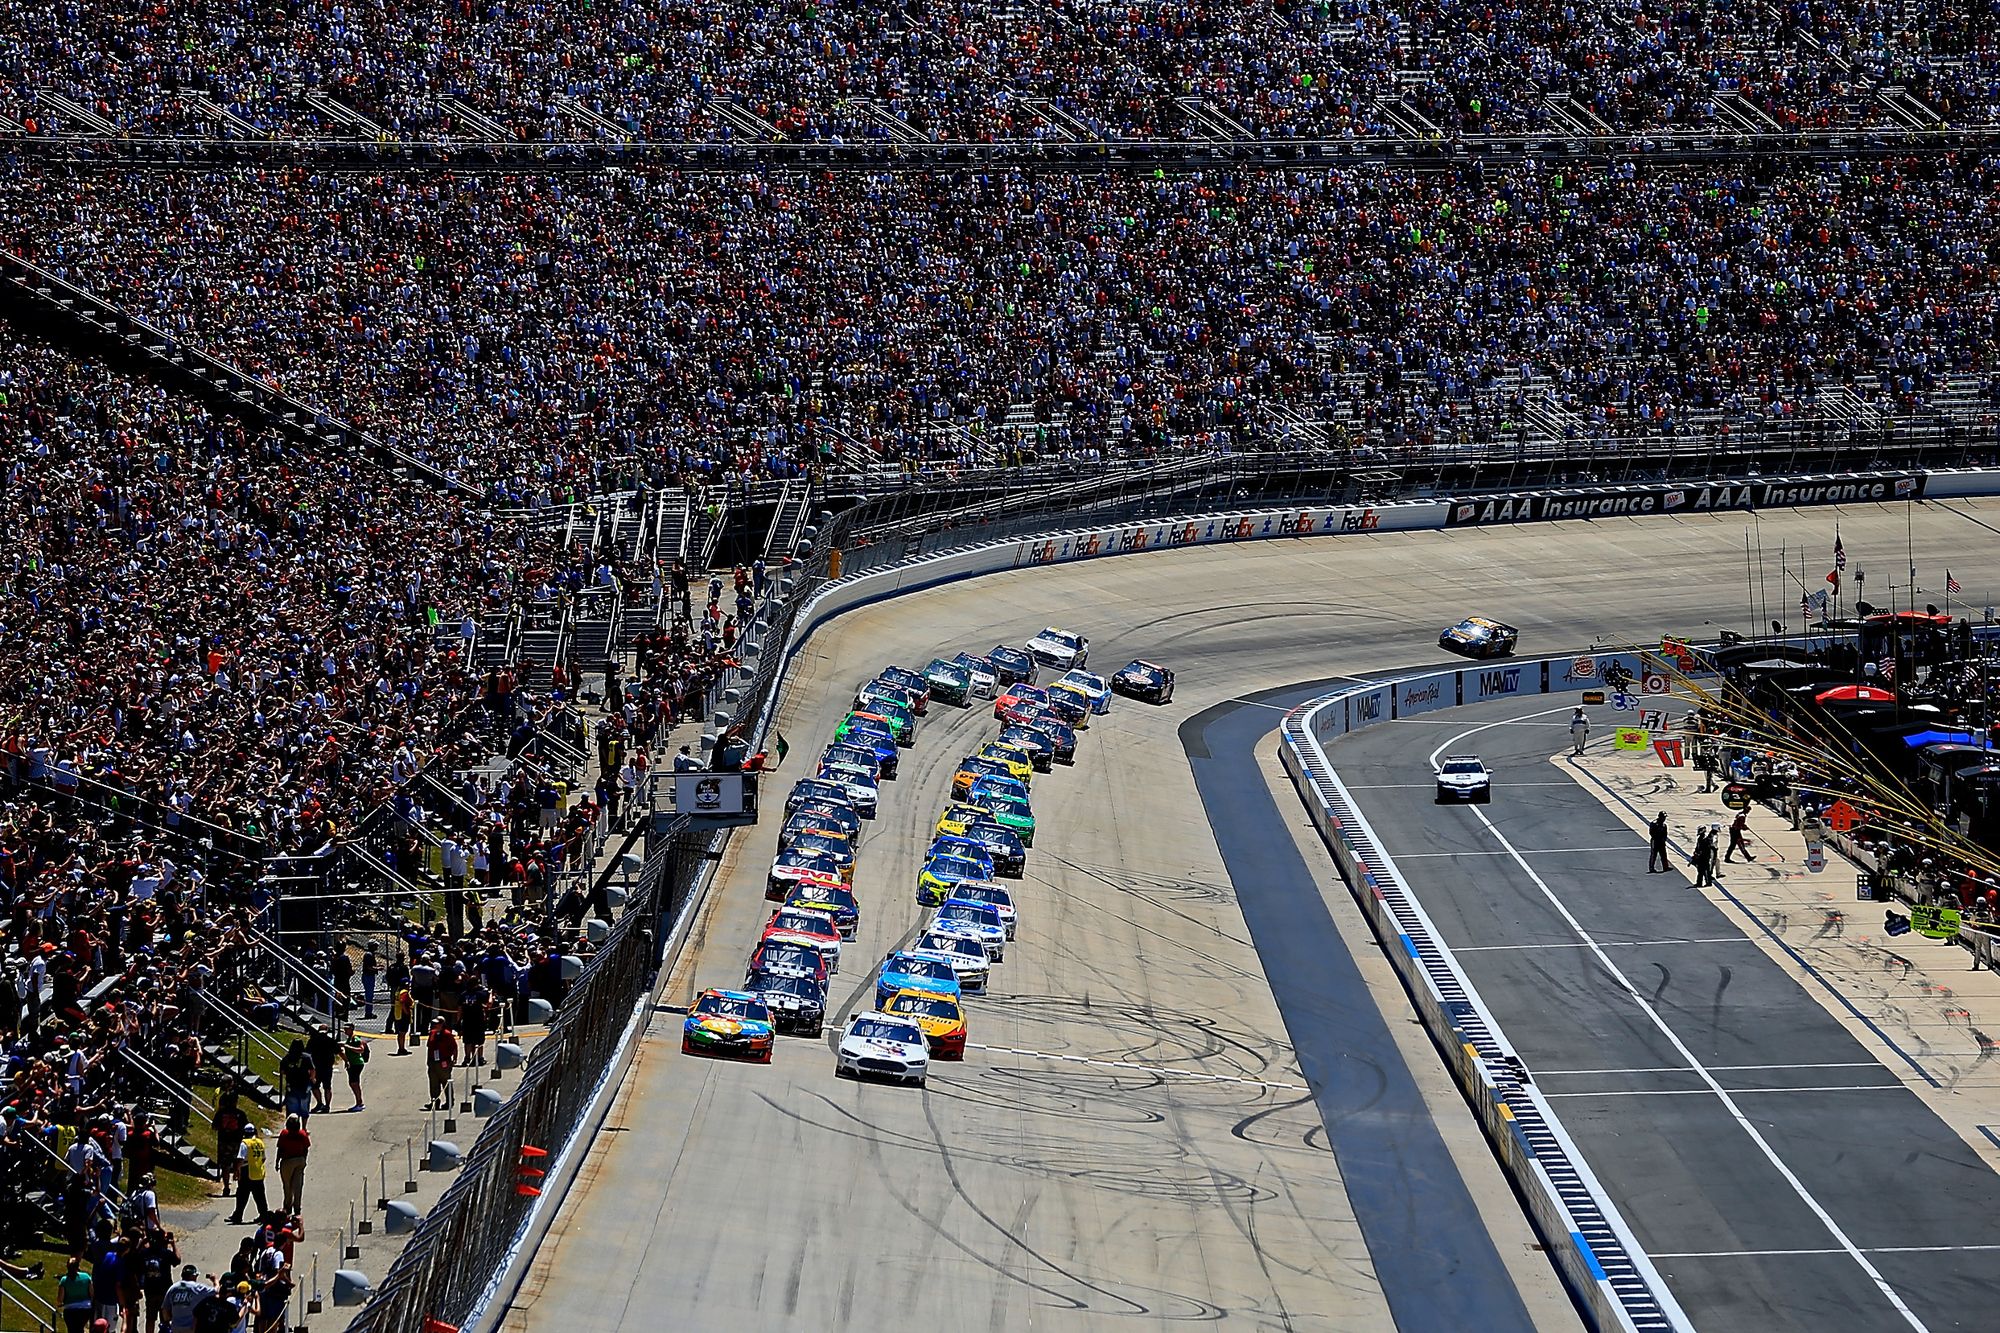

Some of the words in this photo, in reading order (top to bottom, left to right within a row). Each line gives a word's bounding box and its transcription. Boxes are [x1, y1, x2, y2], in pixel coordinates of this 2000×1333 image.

[1694, 486, 1751, 508] AAA
[1762, 483, 1885, 505] Insurance
[1340, 508, 1381, 531] FedEx
[1479, 498, 1531, 522] AAA
[1541, 496, 1655, 518] Insurance
[1167, 521, 1199, 545] FedEx
[1220, 517, 1256, 539] FedEx
[1278, 512, 1316, 534] FedEx
[1029, 539, 1057, 563] FedEx
[1073, 534, 1101, 557] FedEx
[1119, 528, 1149, 551] FedEx
[778, 867, 833, 881] 3M
